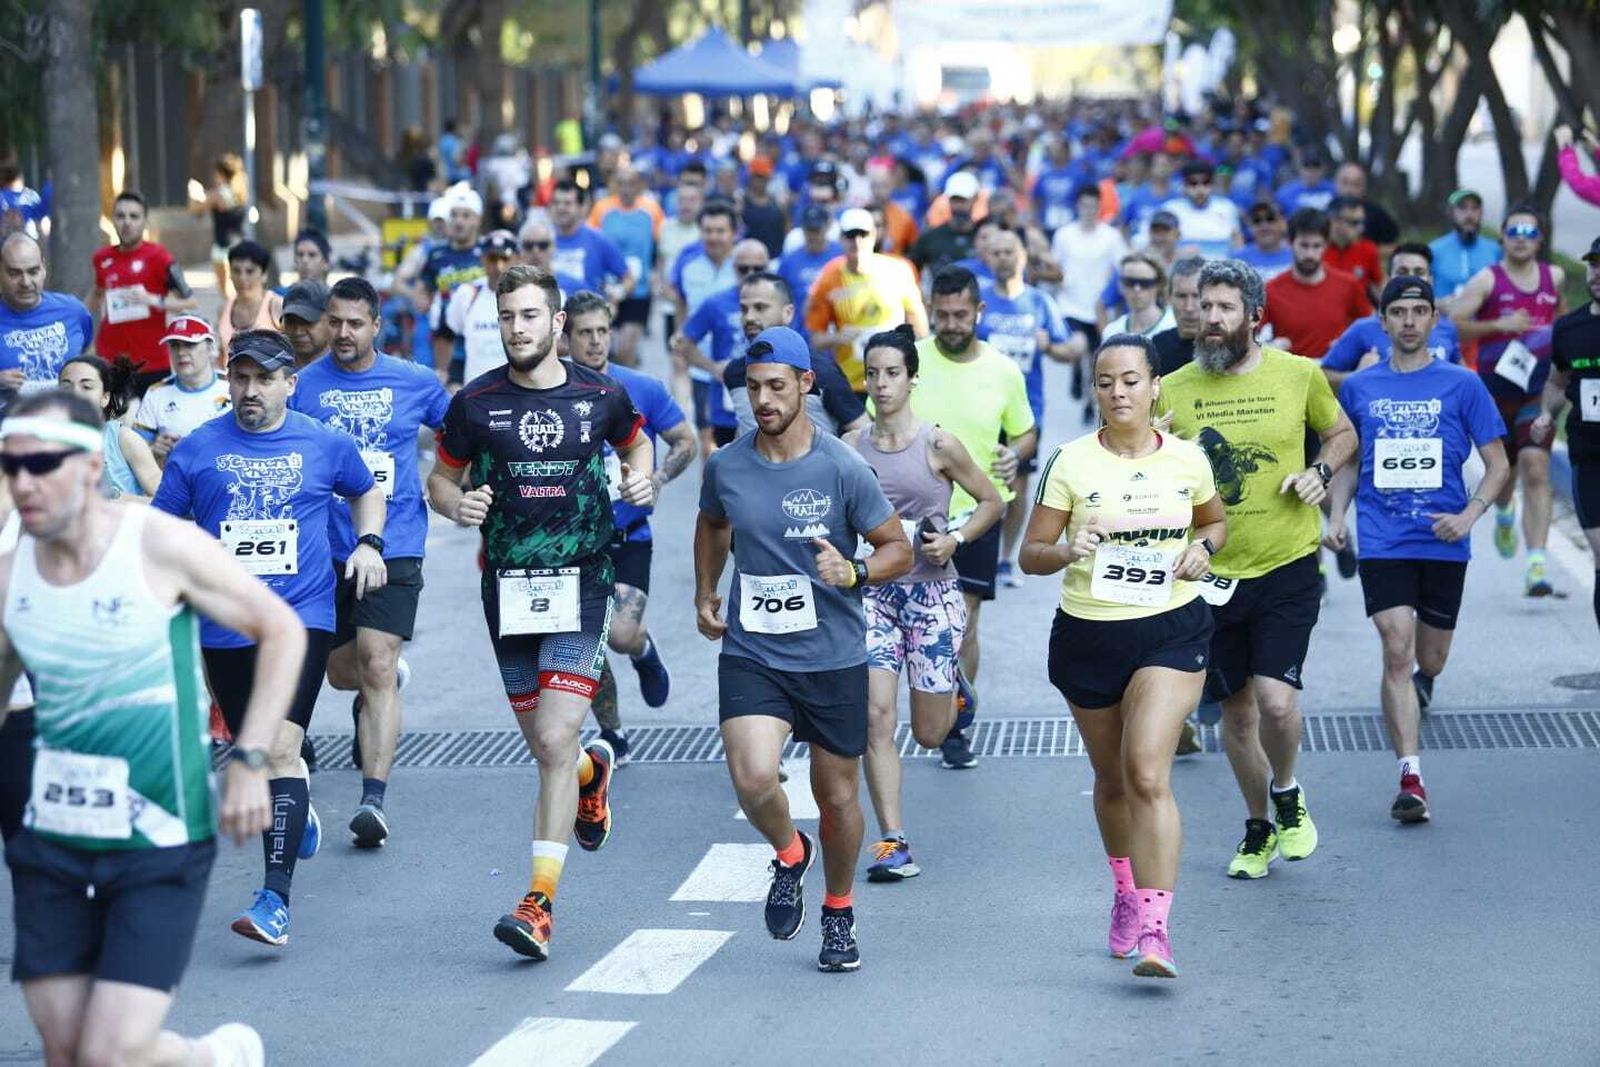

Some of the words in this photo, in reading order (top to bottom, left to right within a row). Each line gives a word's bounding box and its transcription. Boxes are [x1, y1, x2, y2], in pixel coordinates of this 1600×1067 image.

[1207, 409, 1234, 419] Media
[526, 424, 558, 435] TRAIL
[507, 460, 579, 477] FENDT
[1382, 457, 1437, 470] 669
[788, 505, 820, 517] TRAIL
[235, 541, 286, 556] 261
[1102, 564, 1167, 586] 393
[530, 598, 550, 613] 8
[752, 595, 806, 614] 706
[44, 782, 115, 809] 253
[269, 793, 297, 864] kalenji
